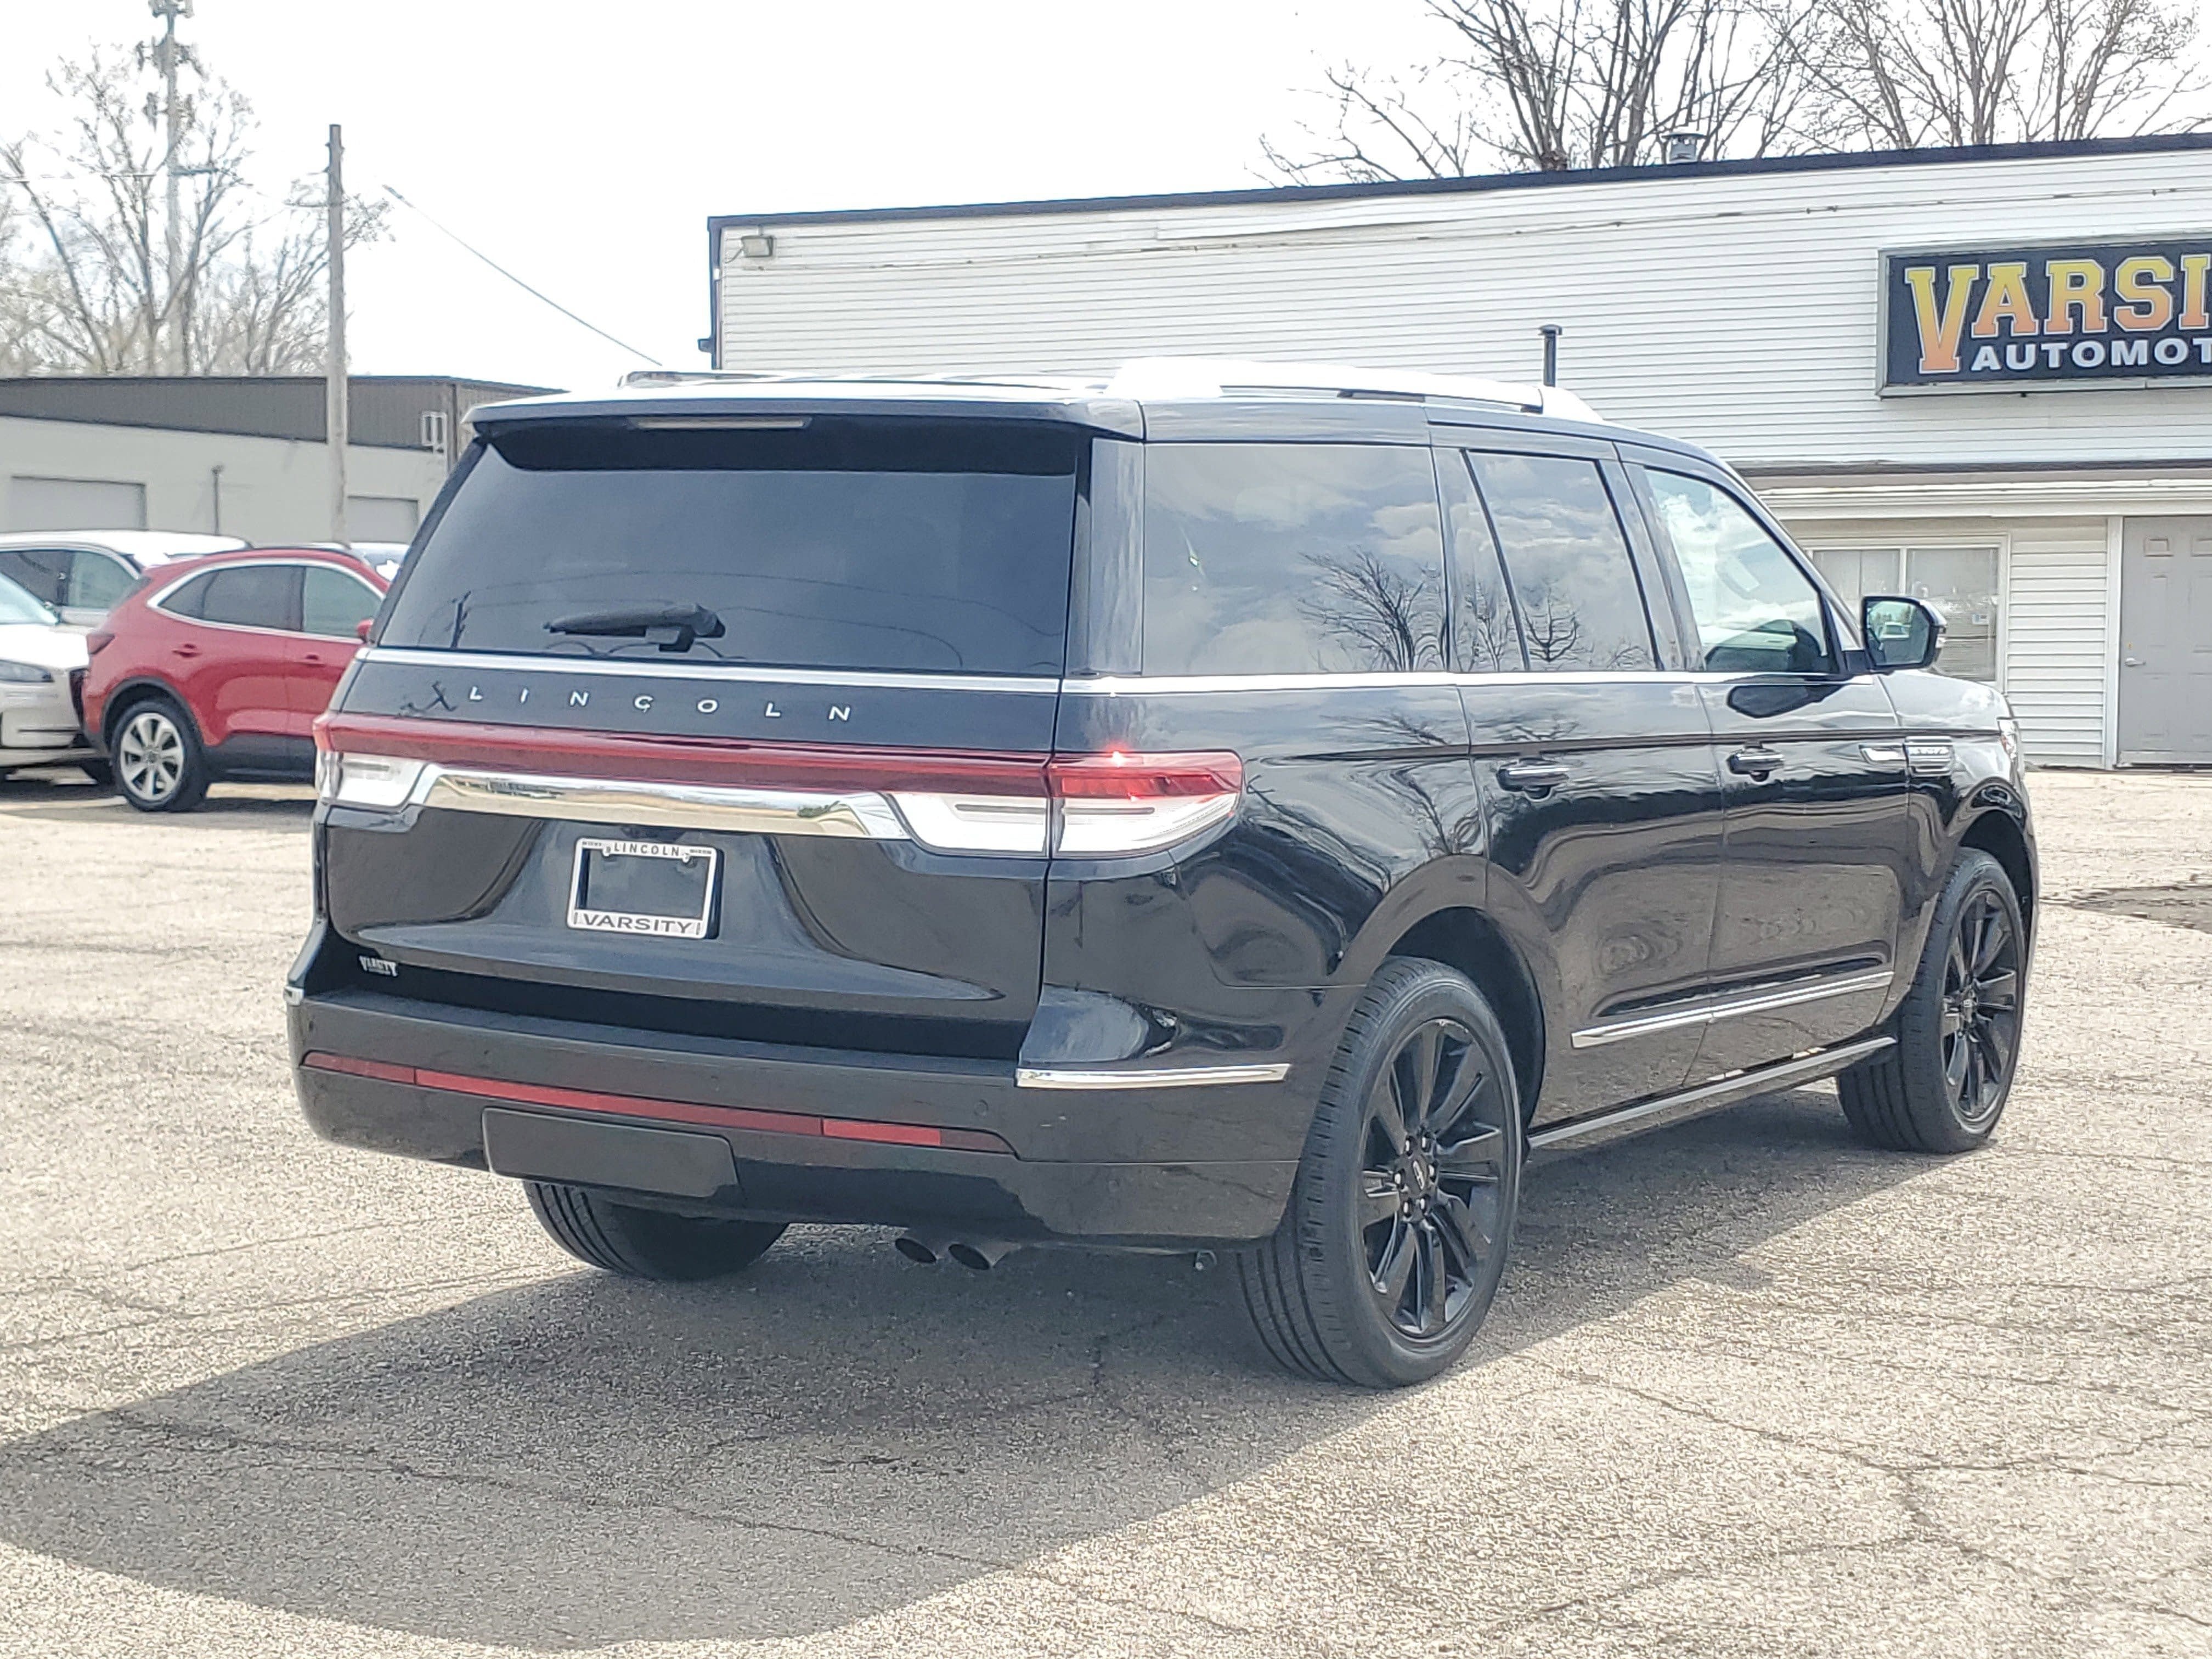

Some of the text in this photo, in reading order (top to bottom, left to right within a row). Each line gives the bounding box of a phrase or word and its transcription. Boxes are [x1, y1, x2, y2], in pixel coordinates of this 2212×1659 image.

[1905, 253, 2211, 374] VARSI
[469, 686, 851, 721] LINCOLN
[614, 842, 679, 856] LINCOLN
[583, 913, 692, 934] VARSITY
